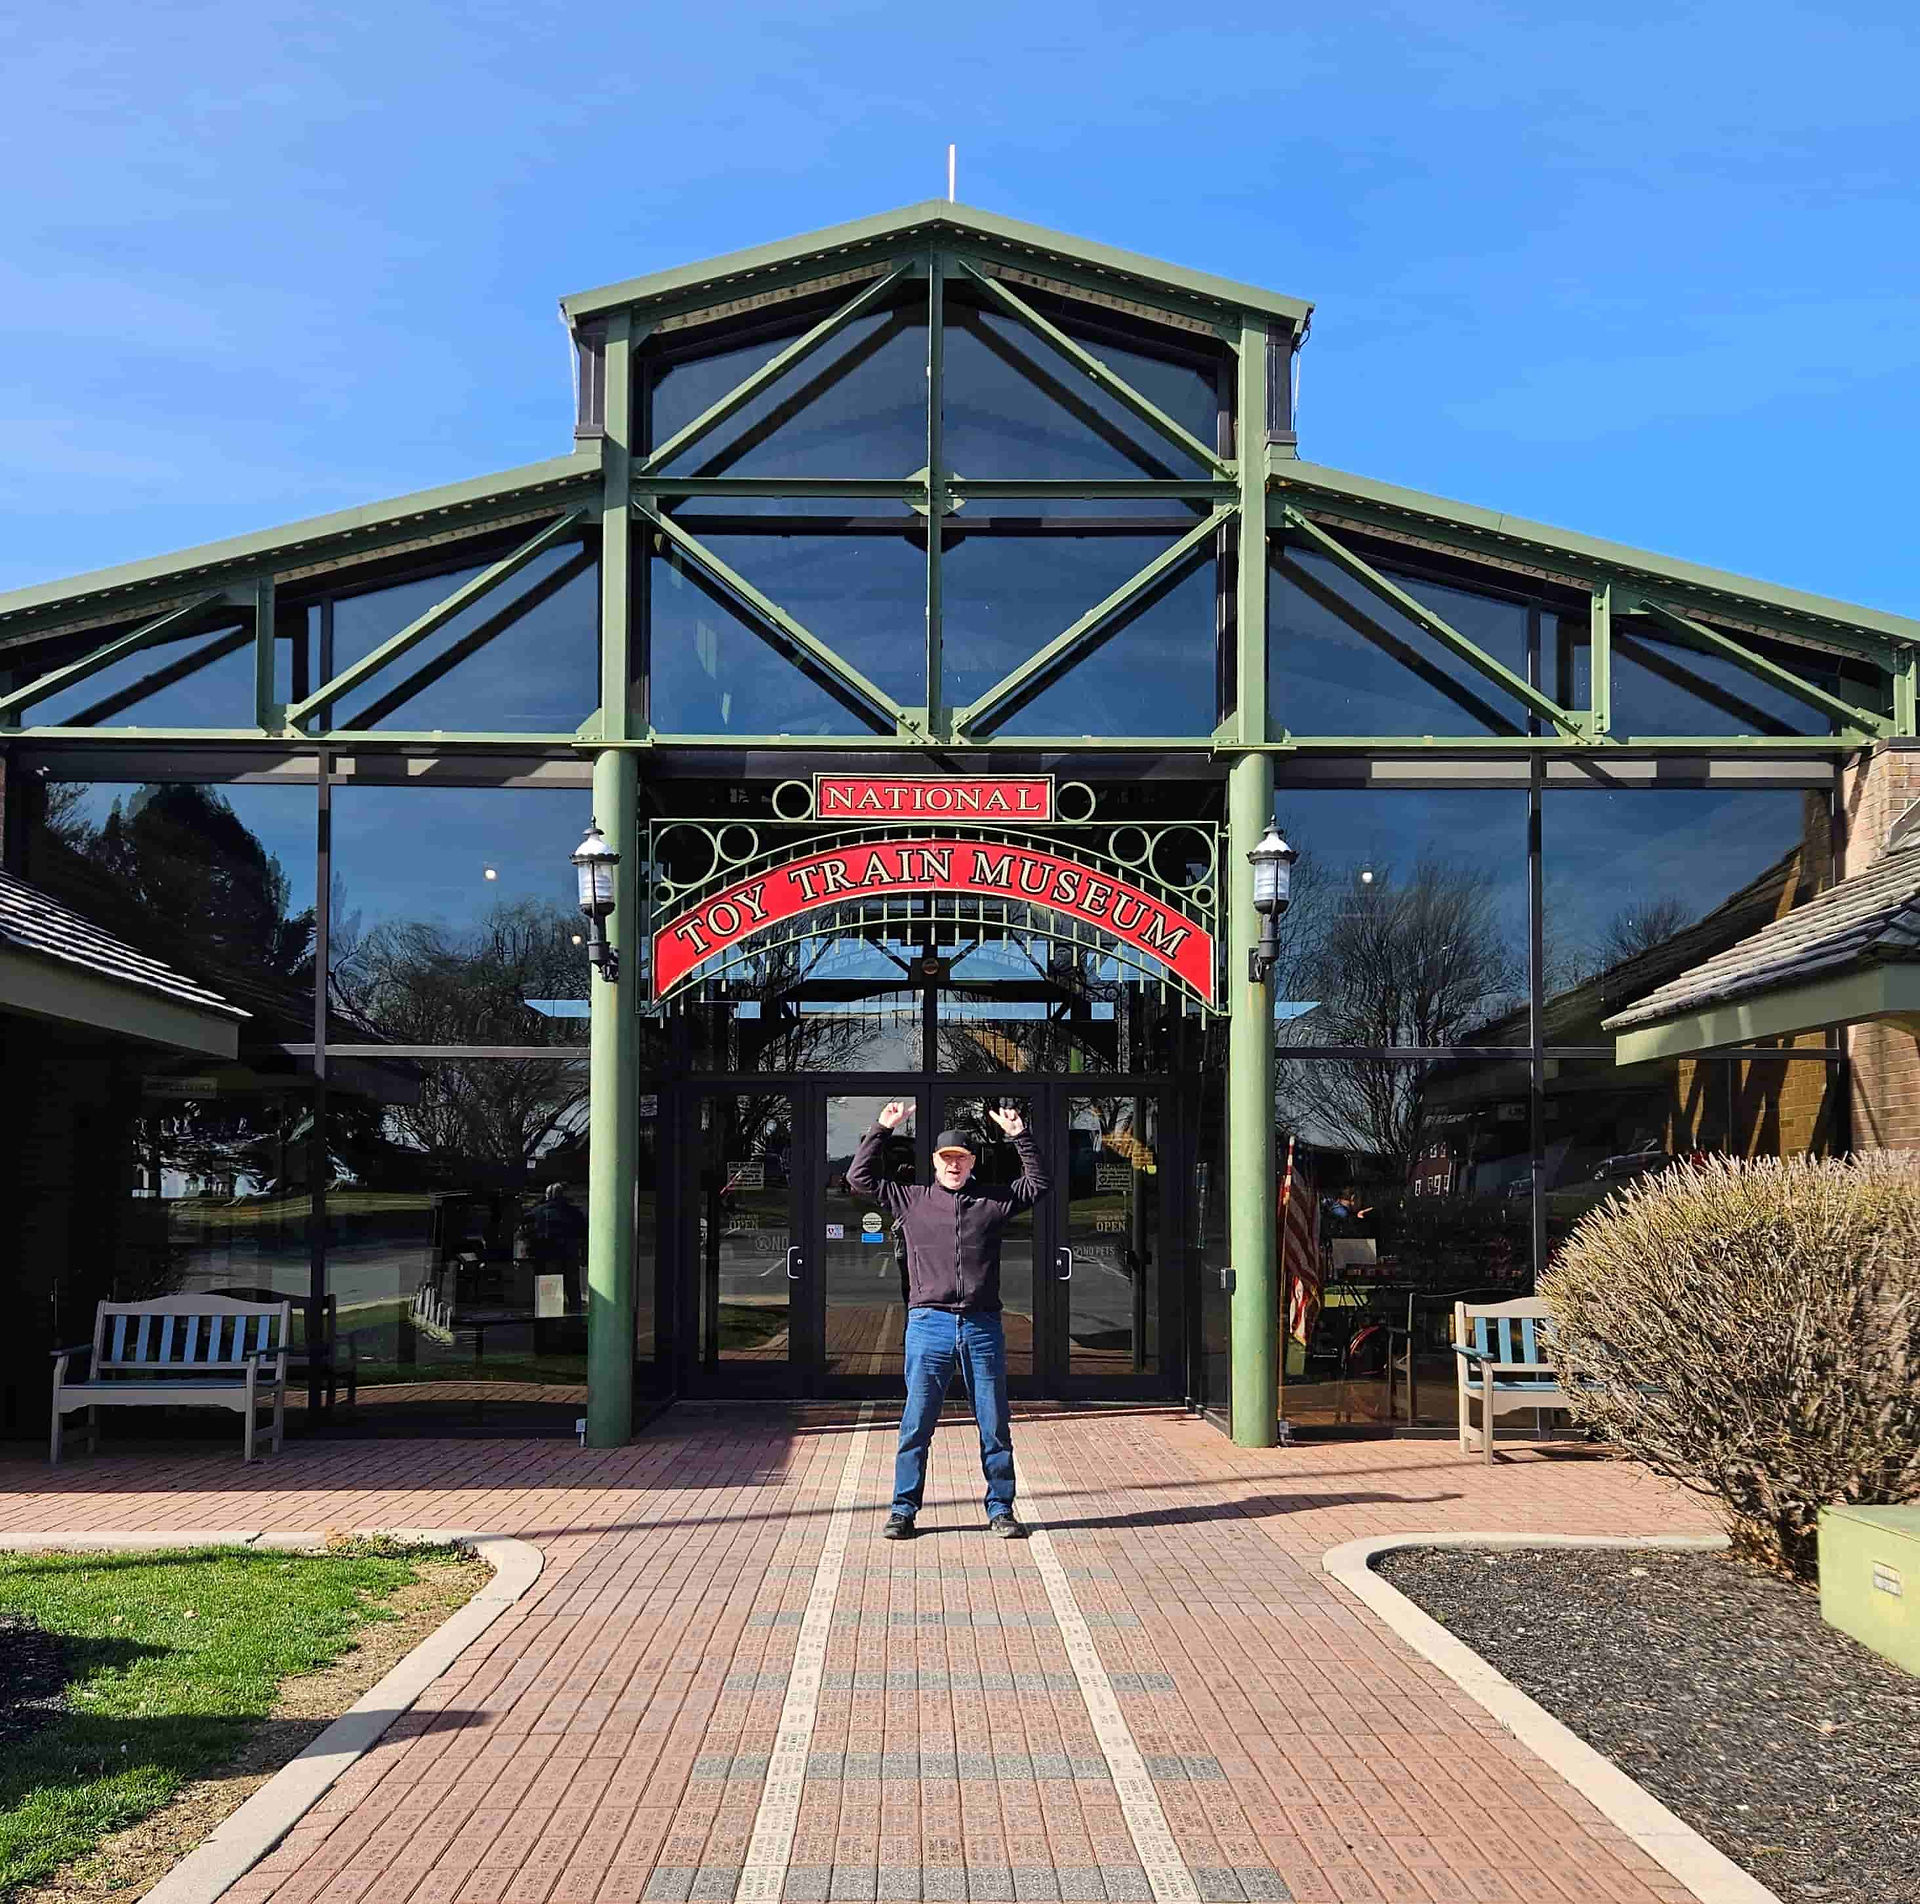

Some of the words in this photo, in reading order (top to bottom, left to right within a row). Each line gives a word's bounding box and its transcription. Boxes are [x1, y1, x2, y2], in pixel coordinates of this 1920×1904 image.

[827, 785, 1041, 811] NATIONAL
[676, 884, 769, 956] TOY
[789, 847, 953, 902] TRAIN
[970, 850, 1191, 958] MUSEUM
[729, 1219, 760, 1231] OPEN
[1096, 1221, 1126, 1232] OPEN
